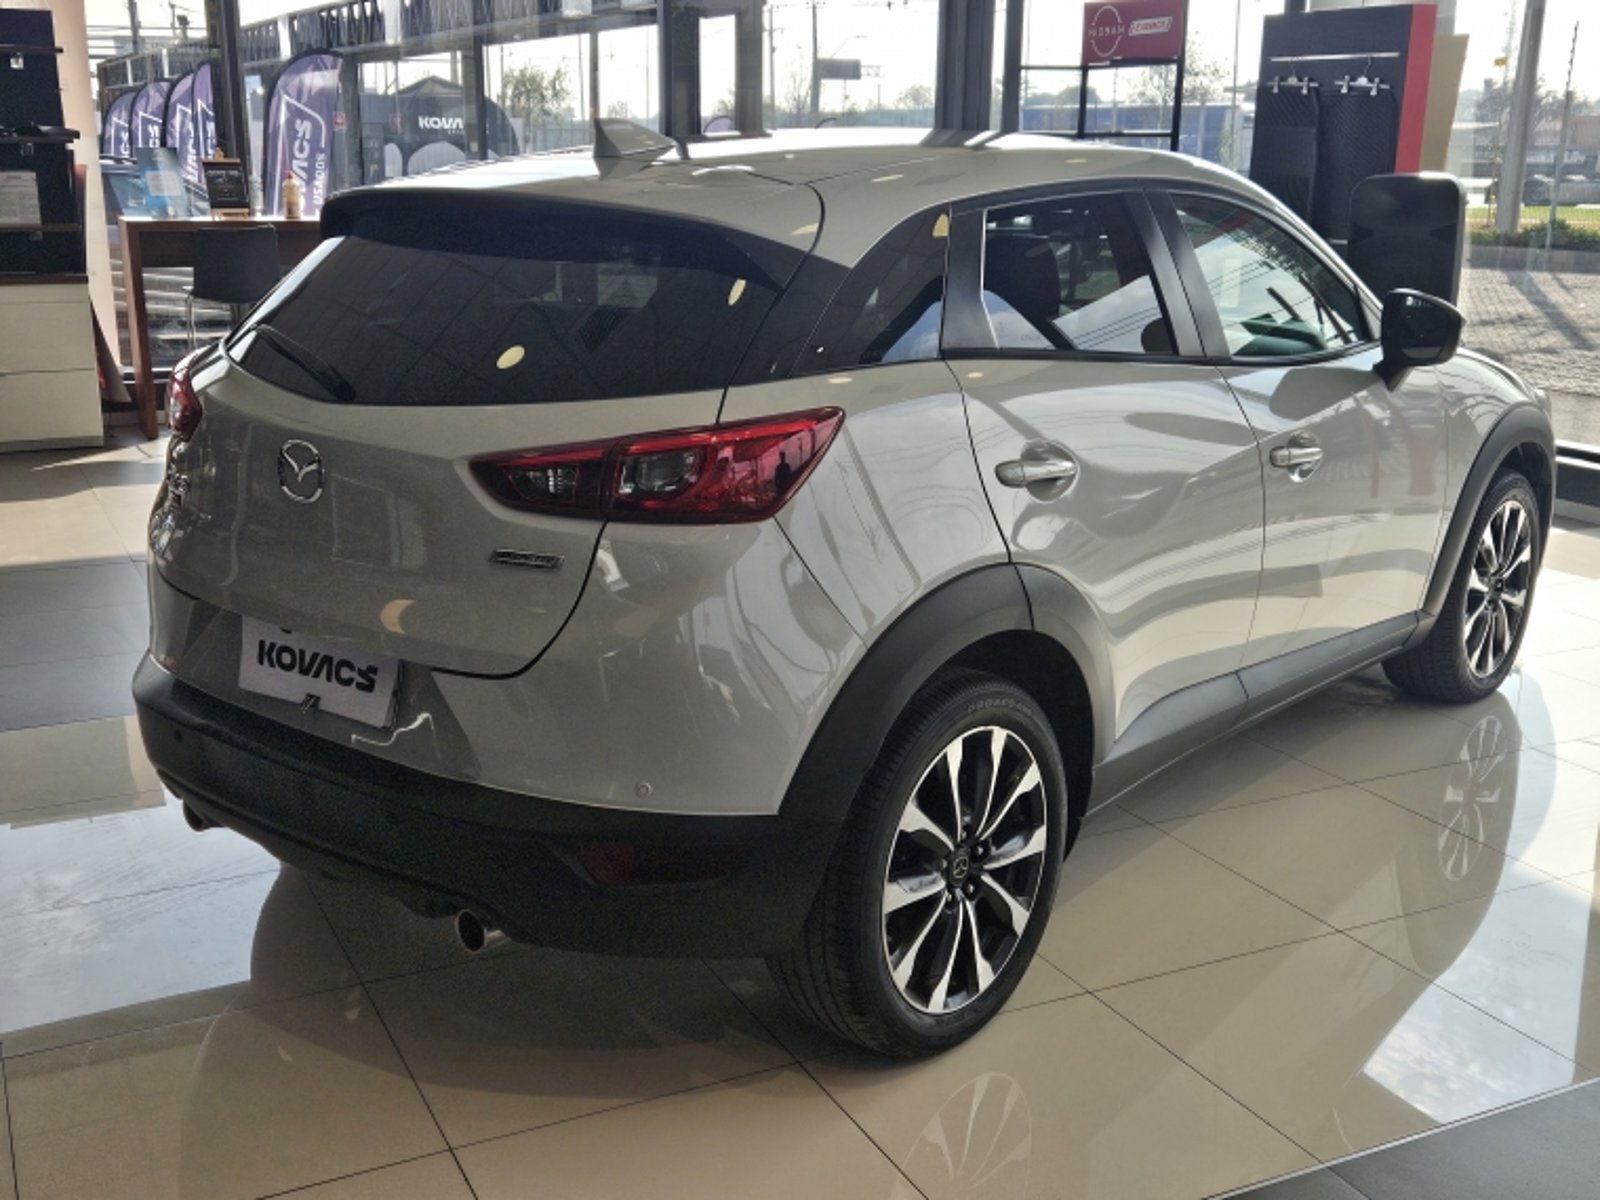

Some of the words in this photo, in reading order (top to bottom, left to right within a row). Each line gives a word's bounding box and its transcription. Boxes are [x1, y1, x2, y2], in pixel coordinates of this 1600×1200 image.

[418, 115, 465, 130] KOVA
[312, 152, 326, 205] USADOS
[257, 639, 379, 693] KOVACS
